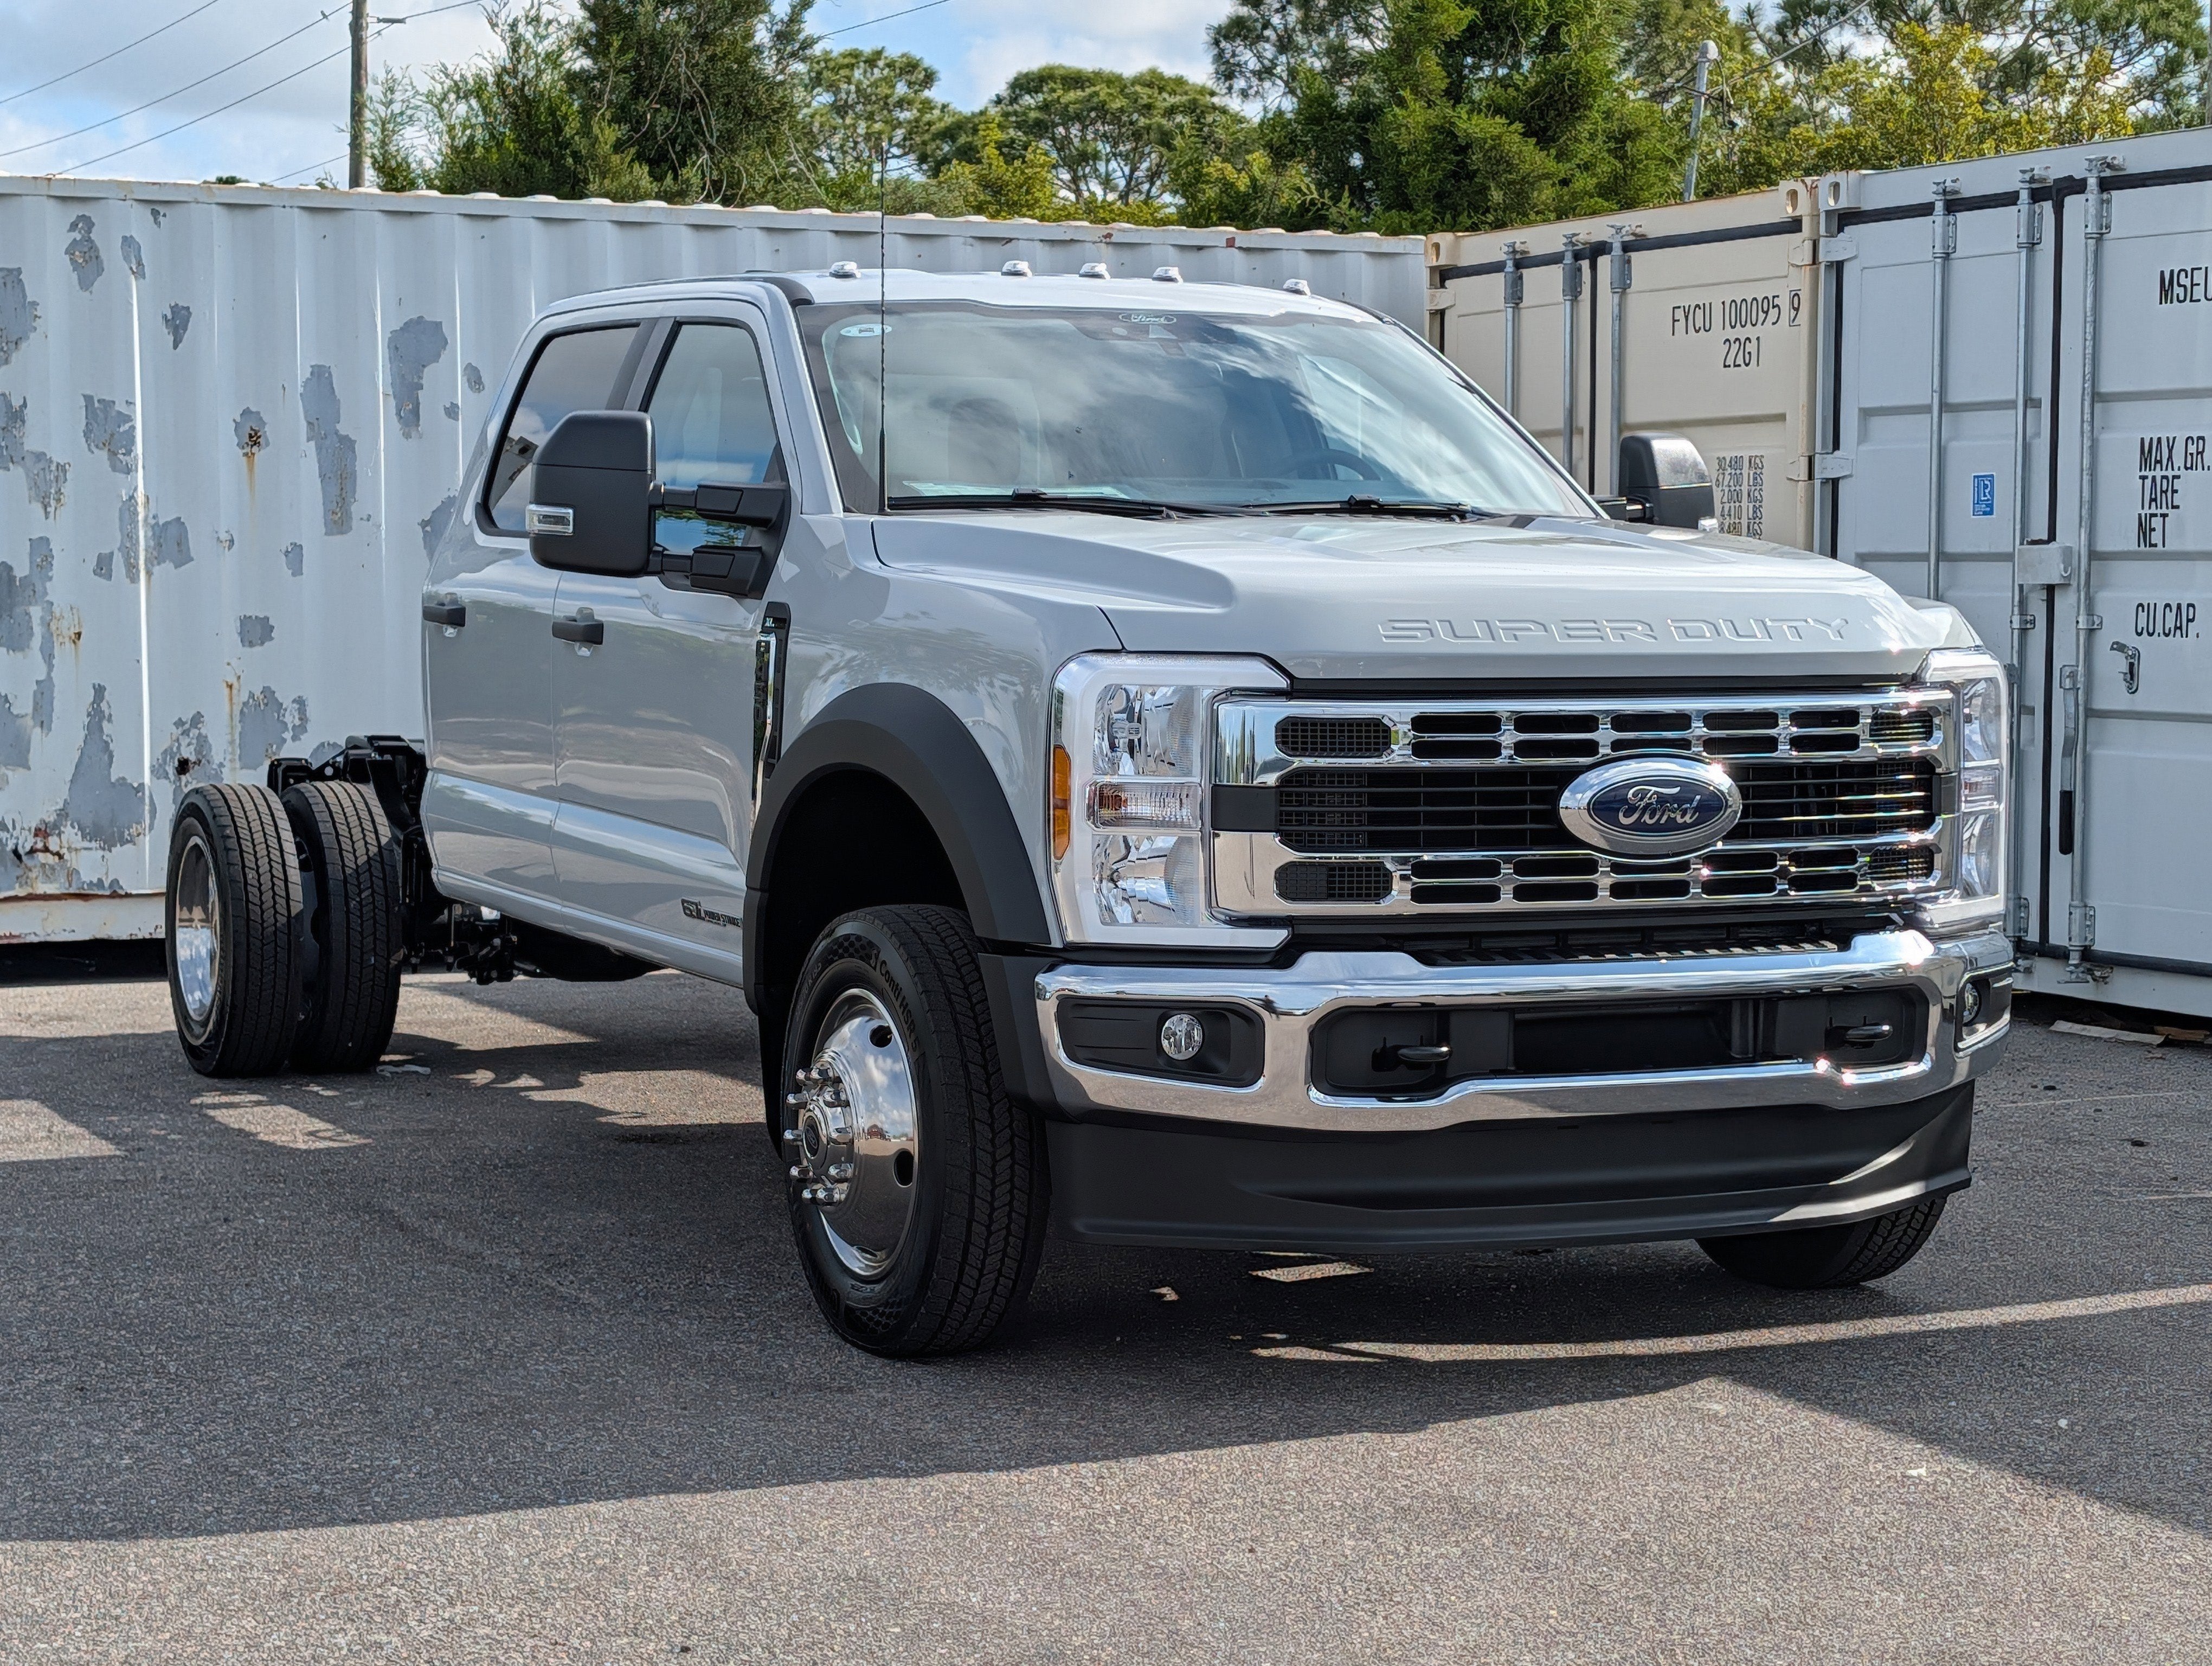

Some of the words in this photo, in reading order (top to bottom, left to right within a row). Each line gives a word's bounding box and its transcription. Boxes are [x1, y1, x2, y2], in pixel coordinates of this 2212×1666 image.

[1672, 302, 1712, 336] FYCU
[1721, 294, 1782, 331] 100095
[1791, 292, 1801, 324] 9
[1723, 336, 1760, 369] 22G1
[2139, 435, 2211, 472] MAX.GR.
[1747, 471, 1764, 487] LBS
[1747, 488, 1763, 504] KGS
[2139, 475, 2181, 511] TARE
[1747, 504, 1763, 521] LBS
[2137, 512, 2170, 548] NET
[1378, 619, 1658, 643] SUPER
[1667, 618, 1849, 642] DUTY
[2134, 602, 2200, 639] CU.CAP.
[1618, 785, 1701, 825] Ford
[879, 959, 903, 1002] Conti
[898, 995, 916, 1038] HSR
[911, 1035, 921, 1052] 5
